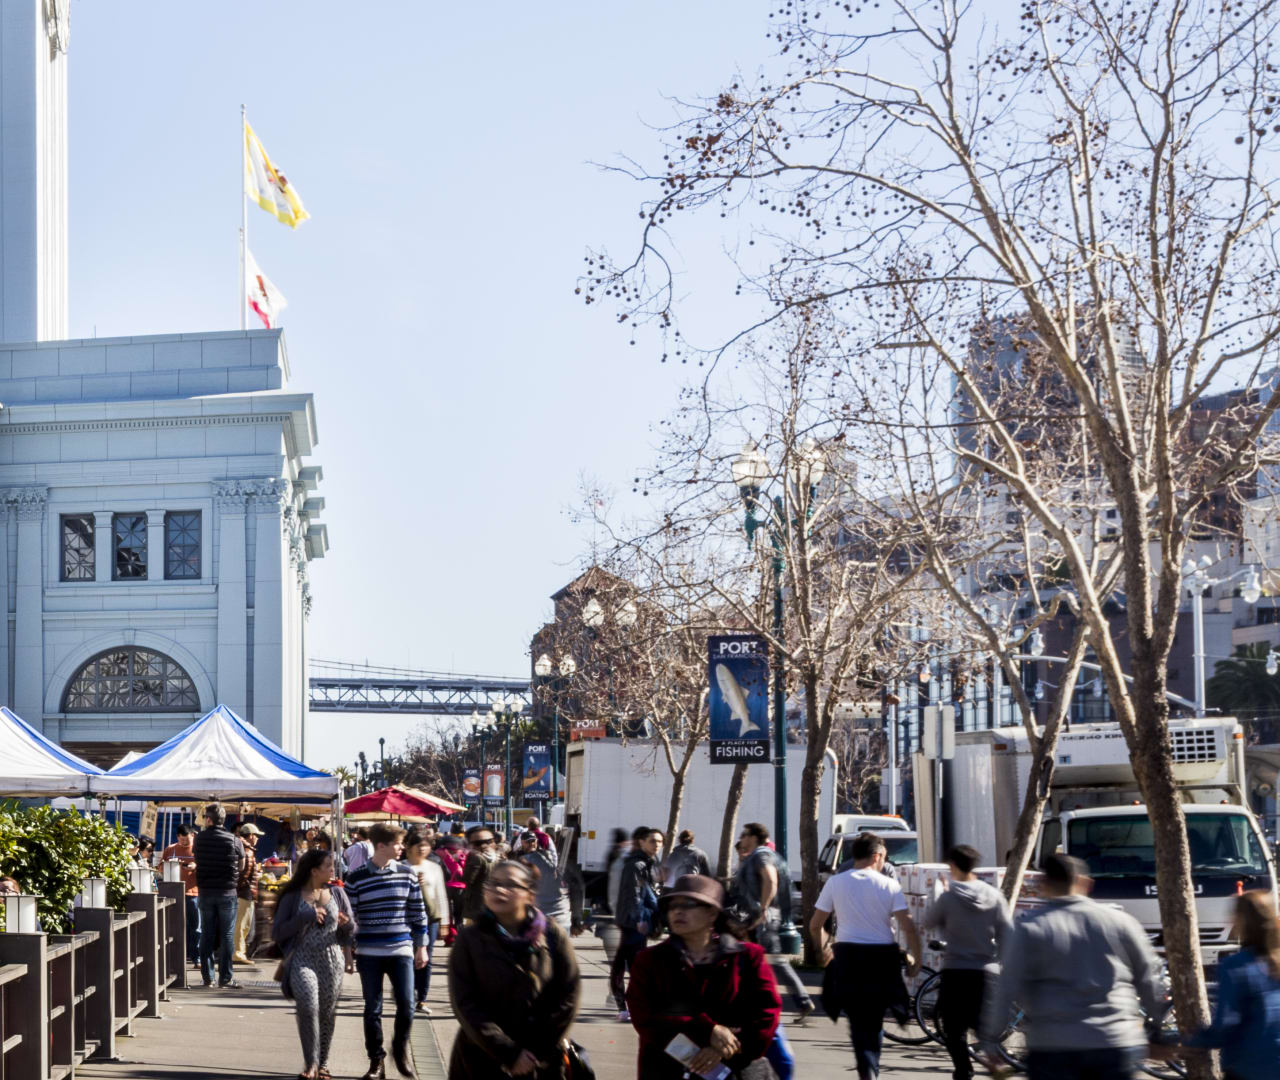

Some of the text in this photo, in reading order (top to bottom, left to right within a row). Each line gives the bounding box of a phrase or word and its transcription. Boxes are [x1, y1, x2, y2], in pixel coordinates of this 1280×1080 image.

[720, 641, 758, 654] PORT
[576, 719, 600, 728] PORT
[716, 746, 765, 757] FISHING
